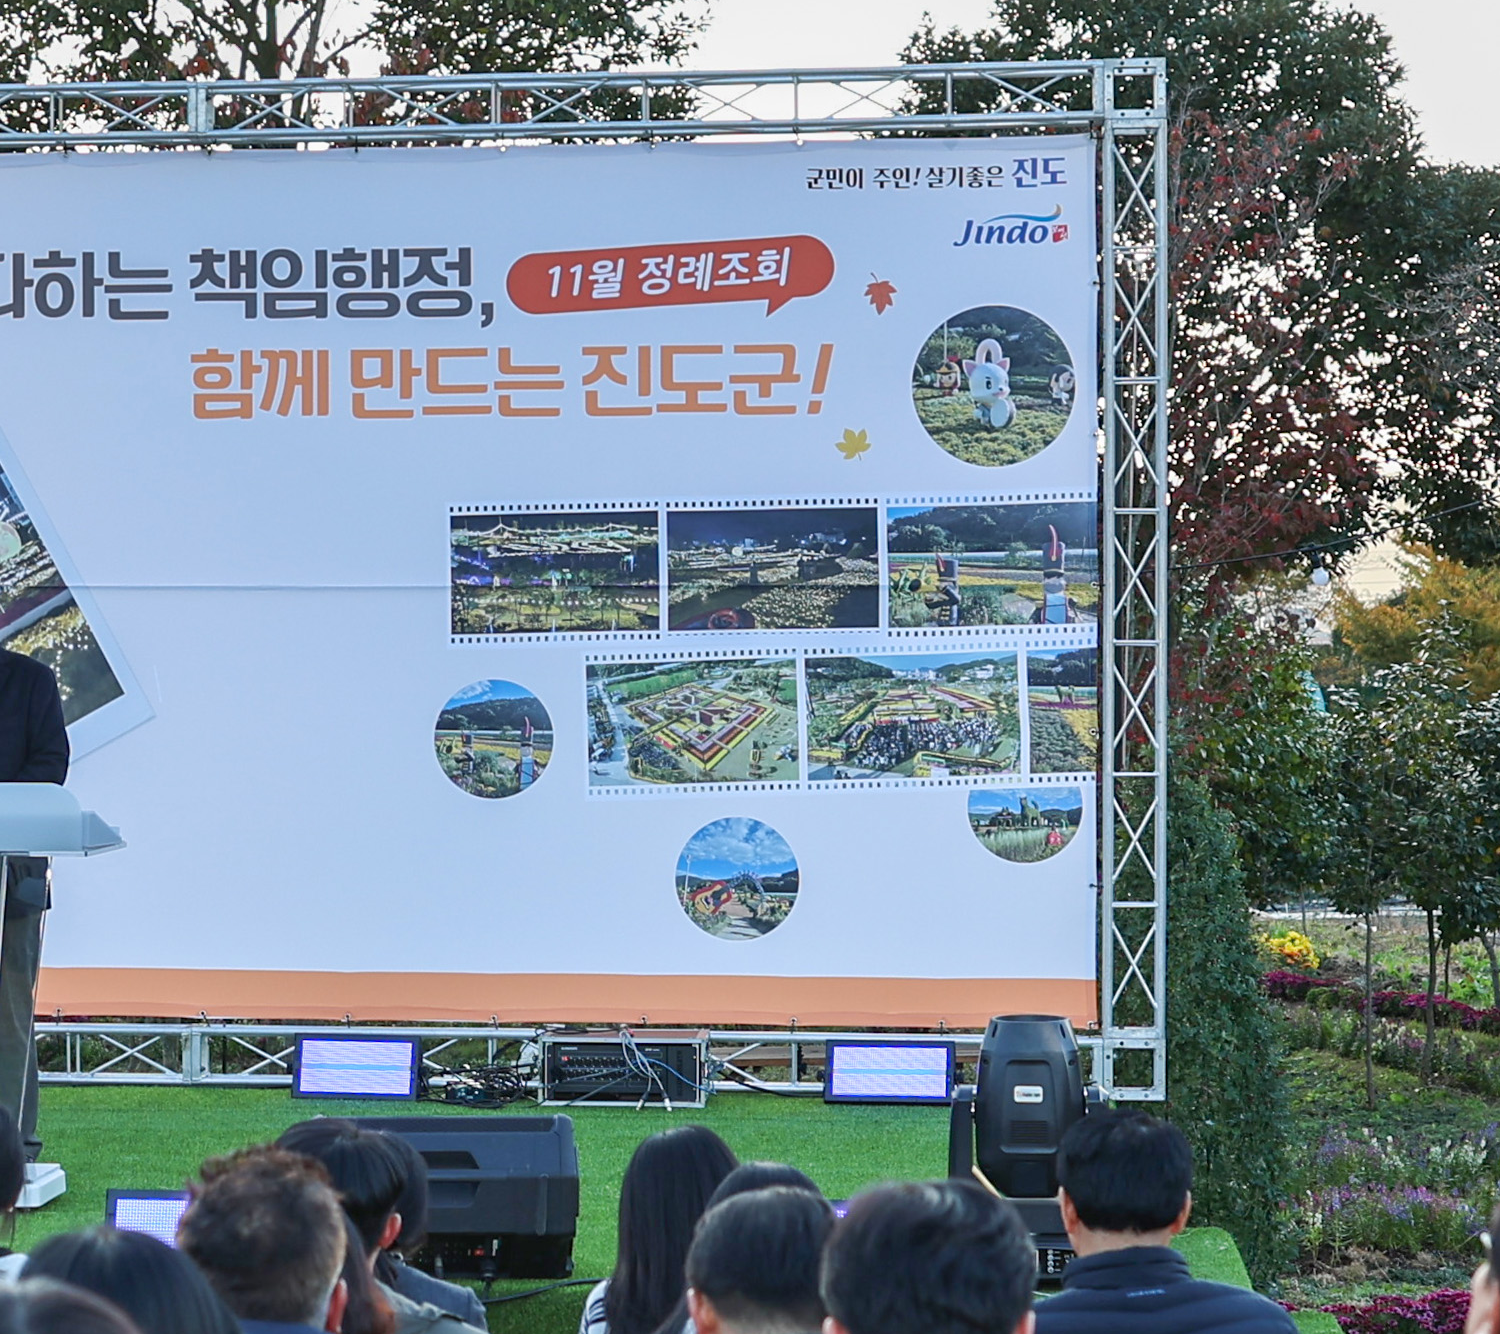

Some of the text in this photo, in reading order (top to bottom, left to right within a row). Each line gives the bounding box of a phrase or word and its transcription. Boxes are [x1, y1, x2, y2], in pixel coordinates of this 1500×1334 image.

[806, 157, 1067, 189] 군민이 주인! 살기좋은 진도
[953, 220, 1048, 247] Jindo
[189, 246, 495, 329] 책임행정,
[548, 246, 791, 299] 11월 정례조회
[190, 343, 834, 419] 함께 만드는 진도군!
